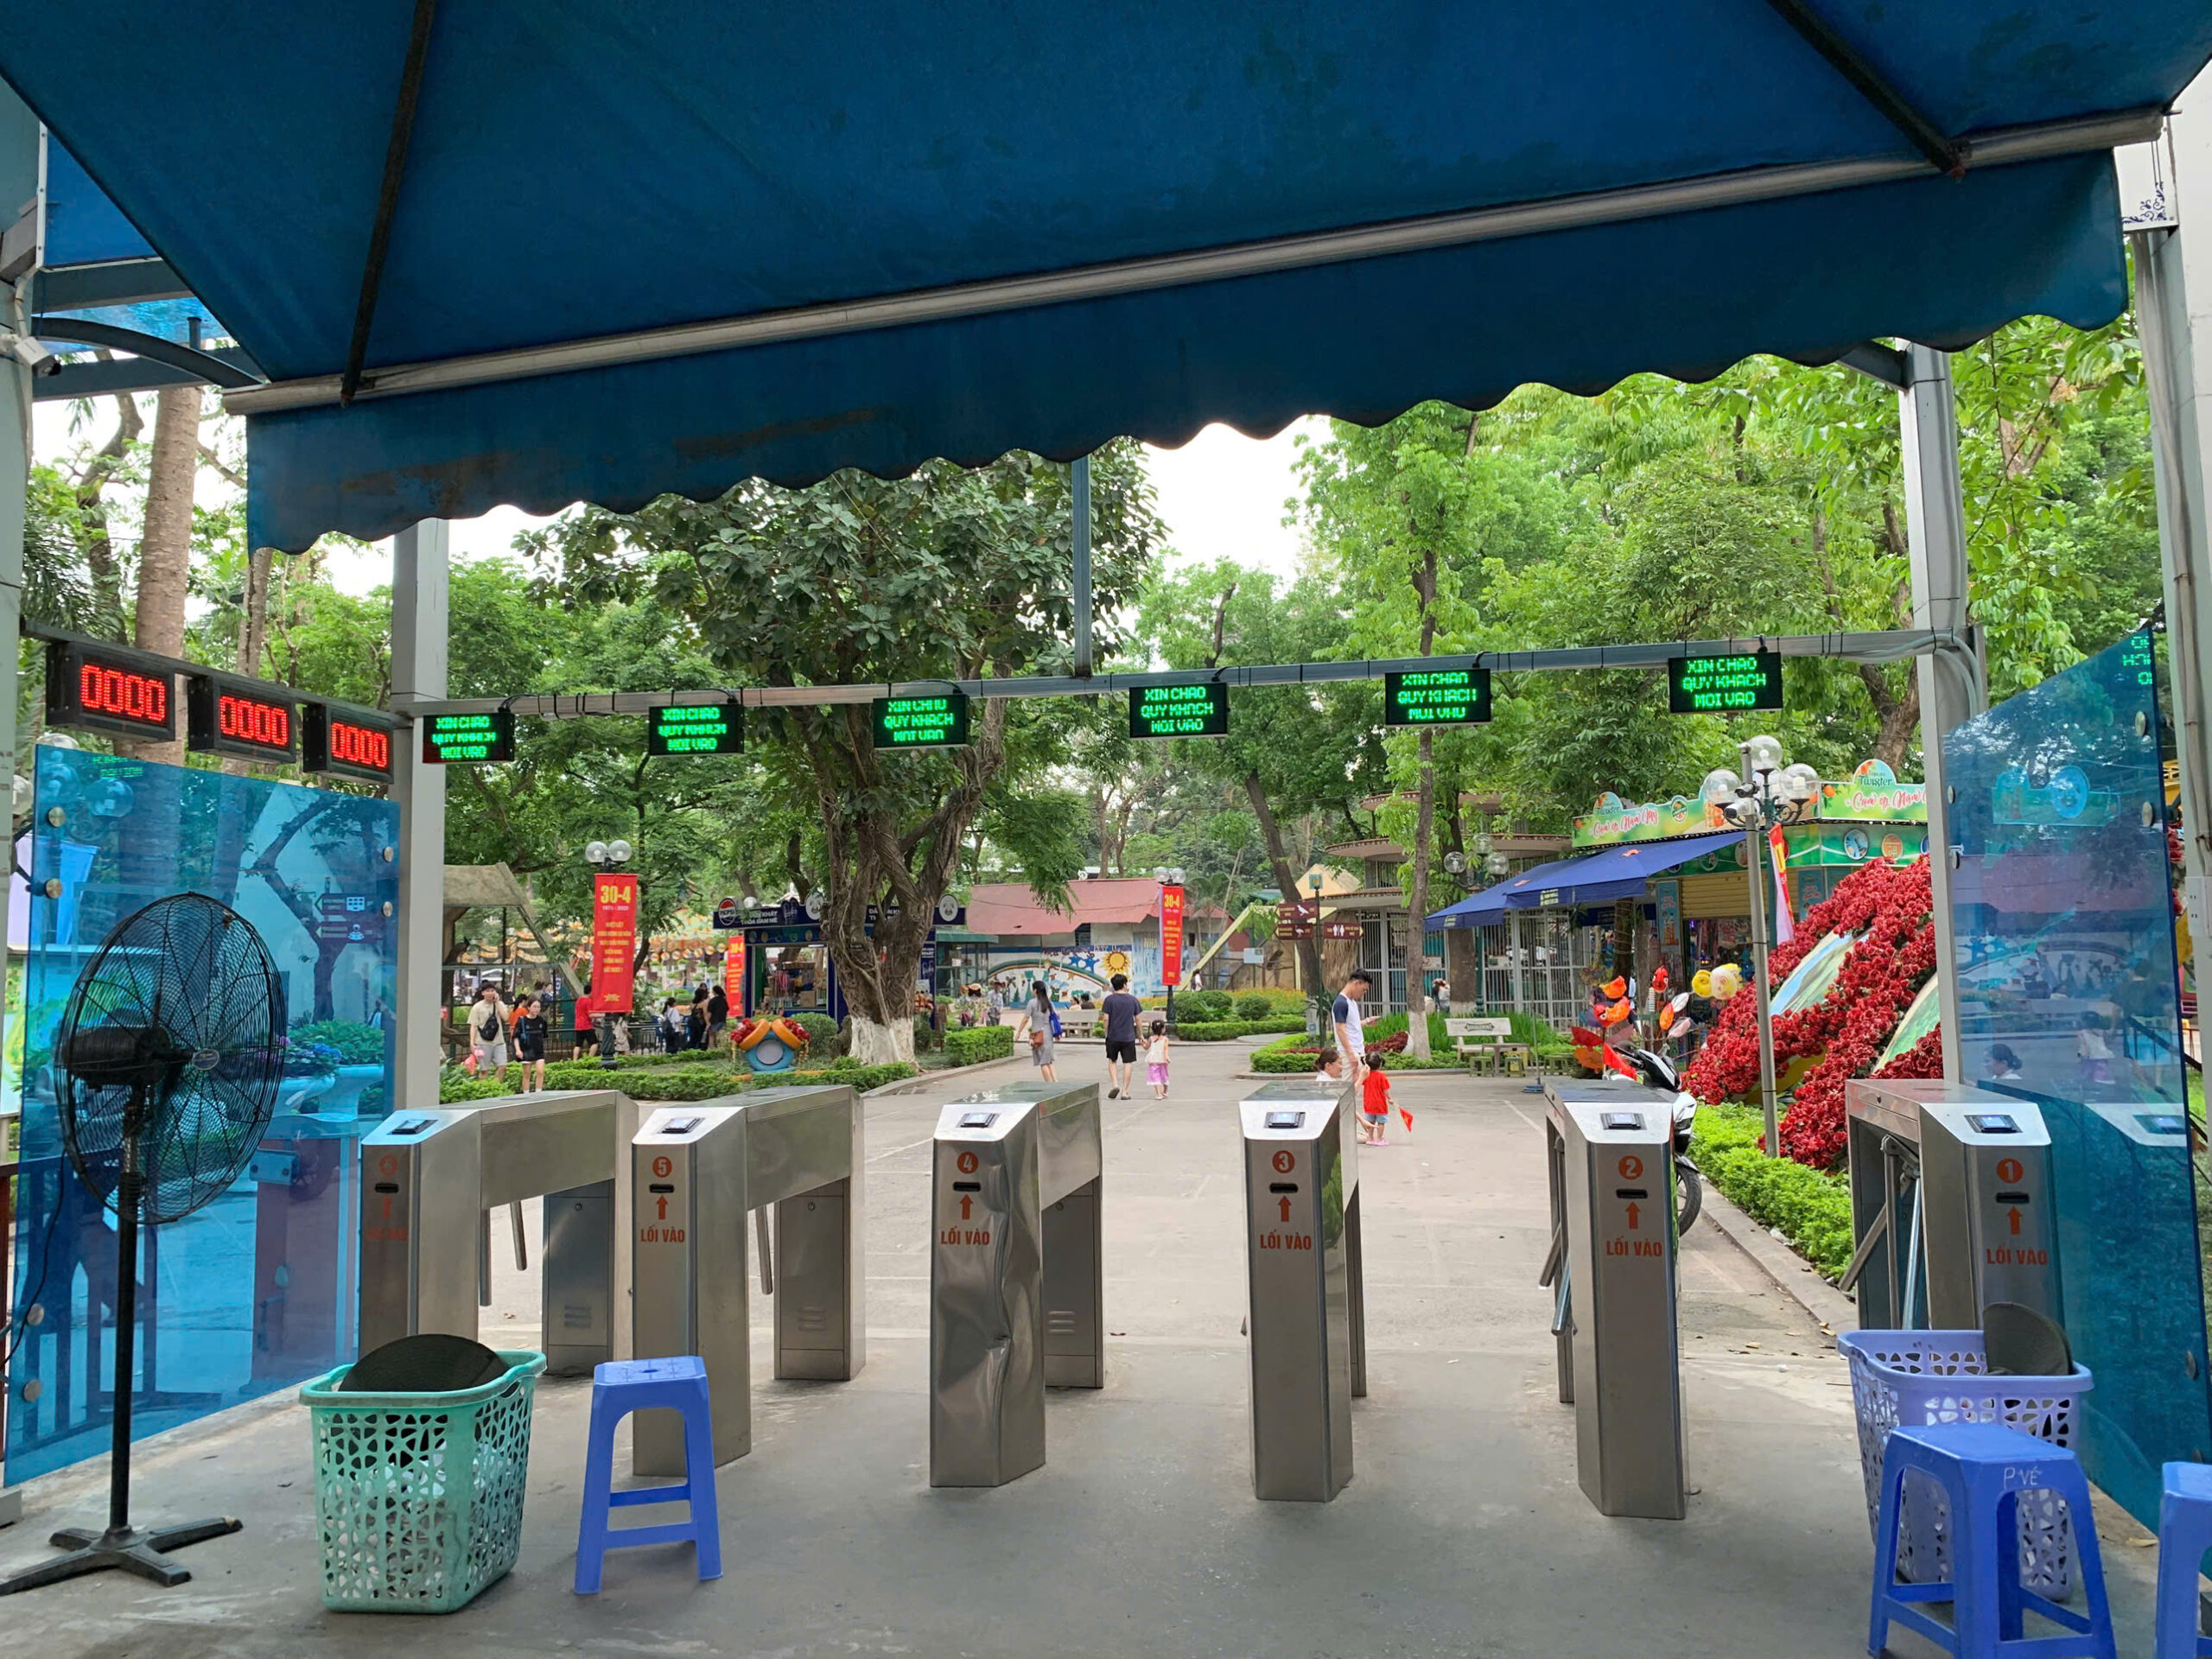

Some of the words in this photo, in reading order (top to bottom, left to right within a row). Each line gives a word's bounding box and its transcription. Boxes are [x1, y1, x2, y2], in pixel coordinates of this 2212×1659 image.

[1687, 658, 1714, 674] XIN
[1716, 657, 1758, 672] CHAO
[1715, 672, 1767, 689] KHACH
[80, 664, 167, 722] 0000
[1144, 688, 1169, 702] XIN
[1171, 686, 1206, 700] CHAO
[1694, 693, 1722, 708] MOI
[1725, 690, 1756, 706] VAO
[1140, 703, 1167, 719] QUY
[218, 695, 289, 747] 0000
[1151, 719, 1175, 733] MOI
[1176, 717, 1204, 732] VAO
[330, 721, 388, 768] 0000
[600, 885, 632, 904] 30-4
[1164, 893, 1180, 908] 30-4
[641, 1224, 659, 1243] LỐI
[941, 1225, 961, 1245] LỐI
[1260, 1229, 1281, 1249] LỐI
[1606, 1236, 1629, 1256] LỐI
